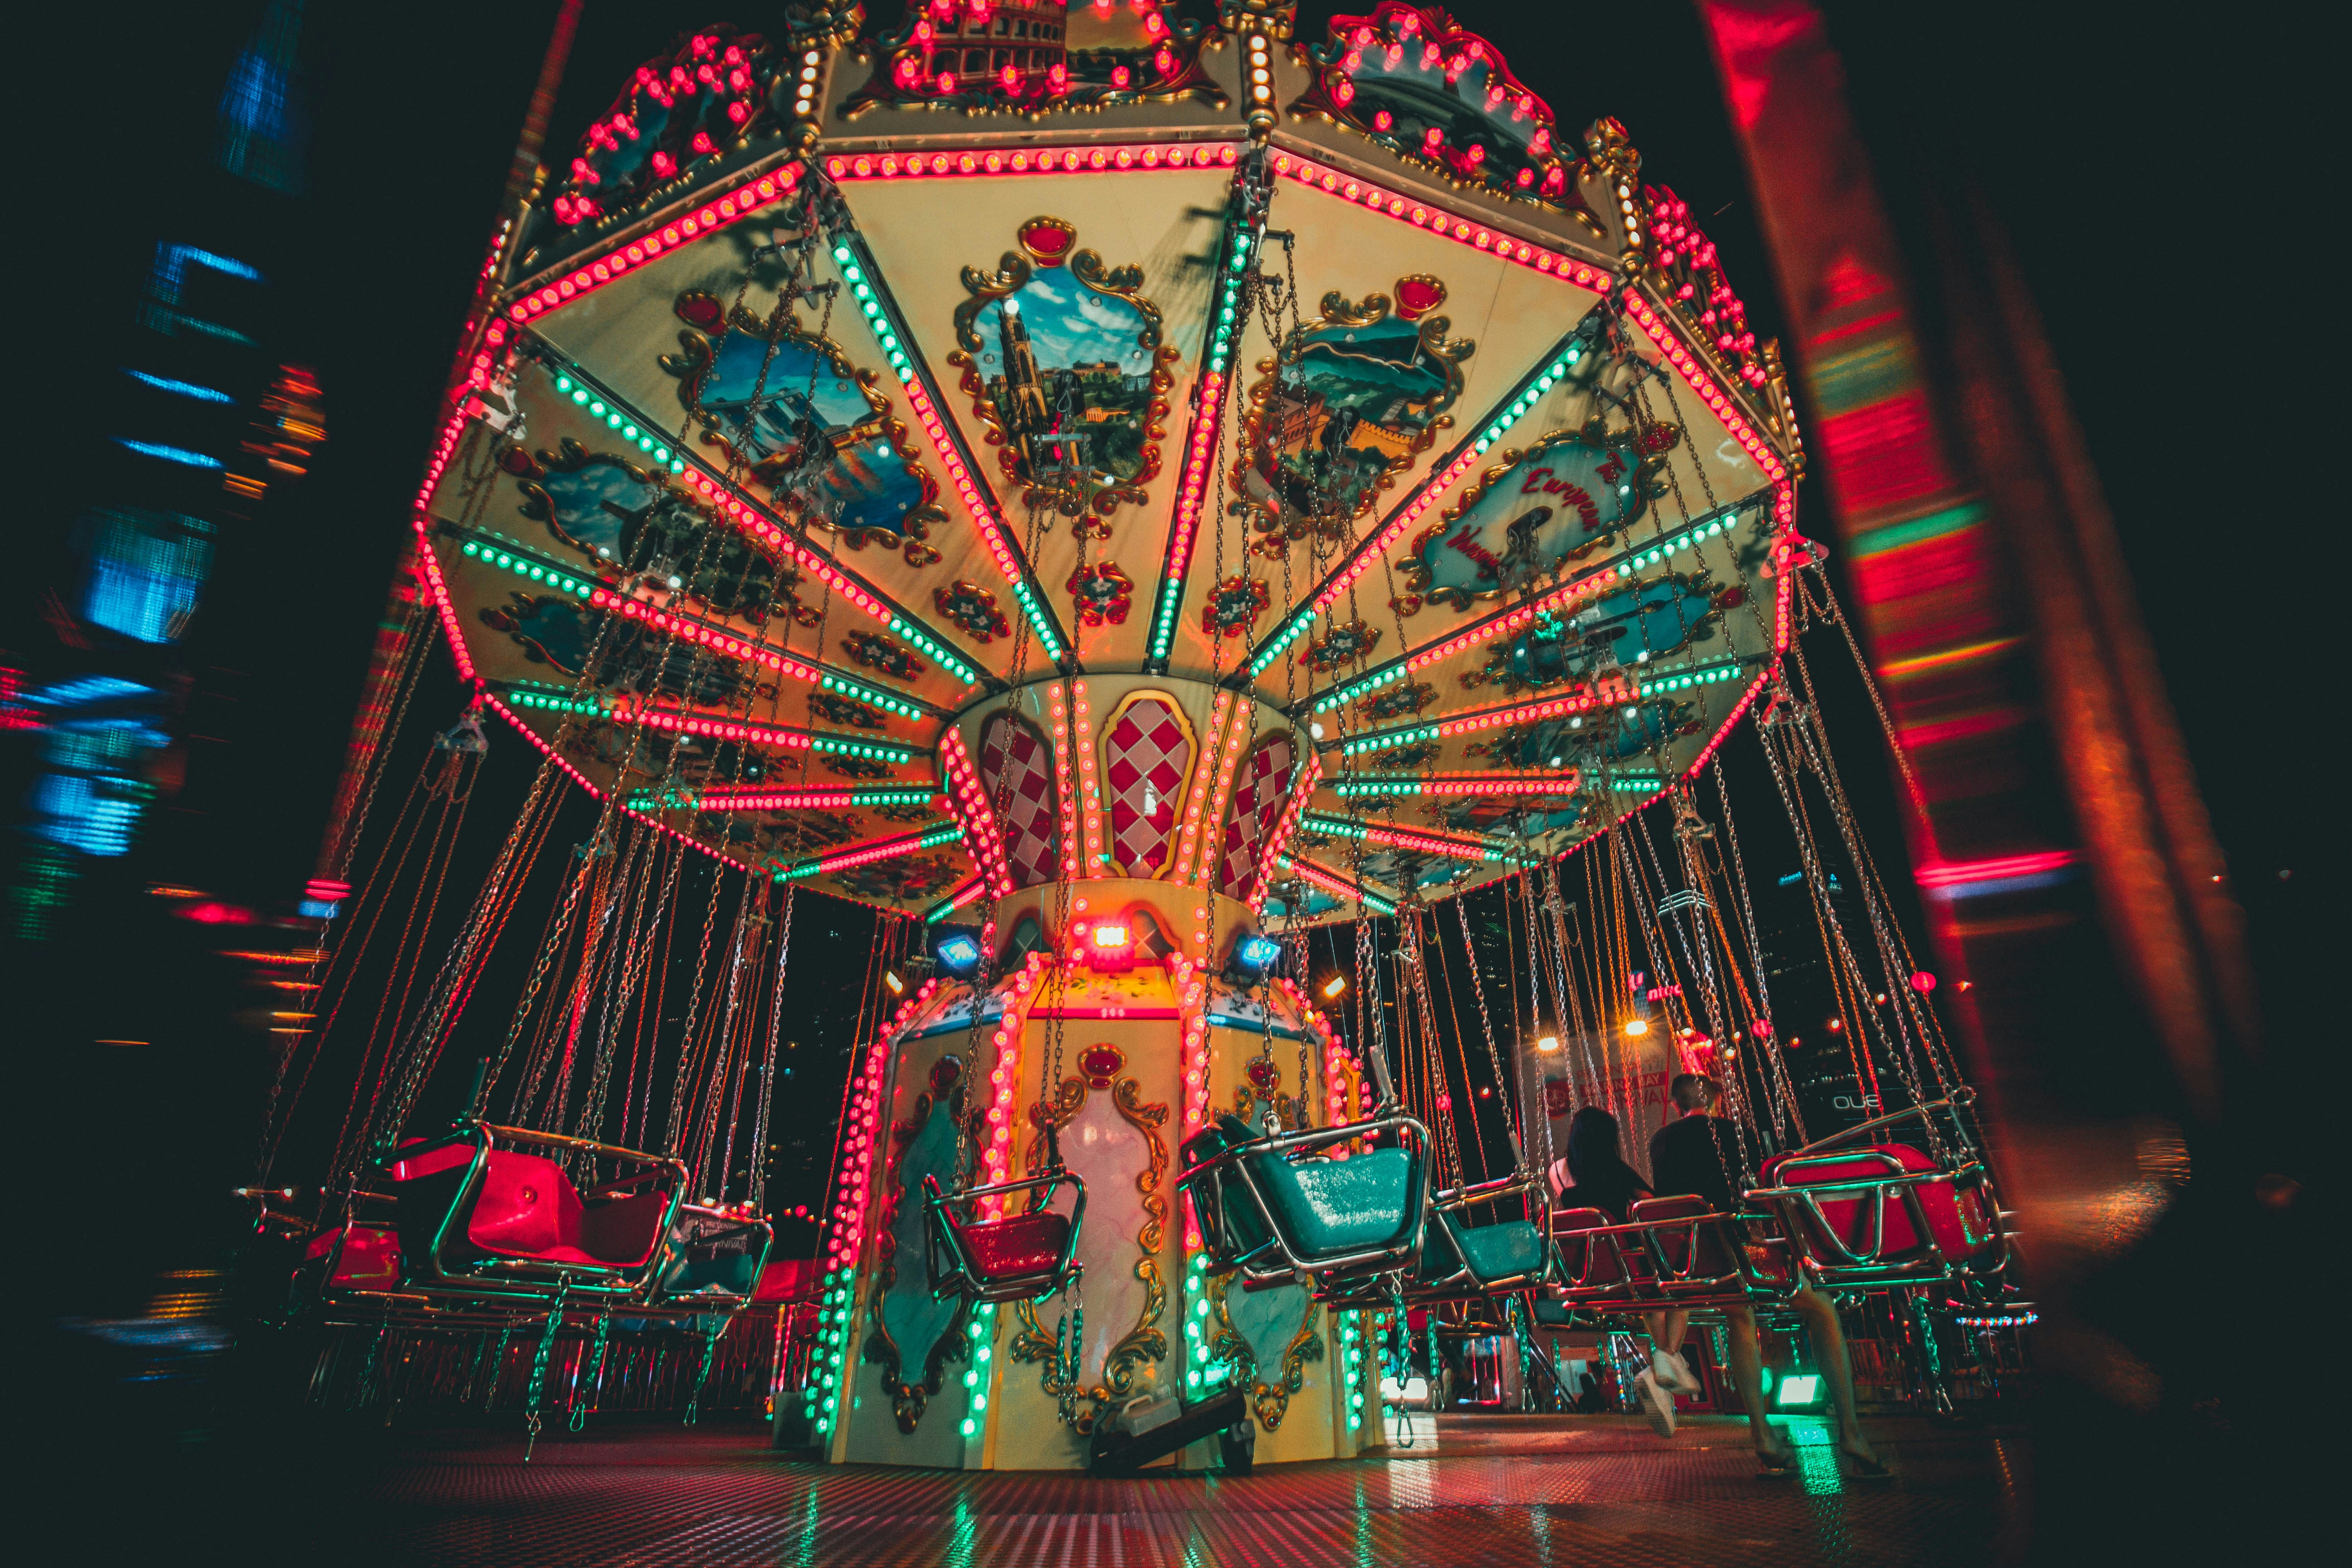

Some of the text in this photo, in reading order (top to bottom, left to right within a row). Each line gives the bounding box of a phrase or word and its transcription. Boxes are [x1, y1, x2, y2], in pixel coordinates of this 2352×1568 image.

[1521, 467, 1600, 531] European
[1780, 871, 1802, 883] Keppel
[1833, 1094, 1881, 1108] OUE
